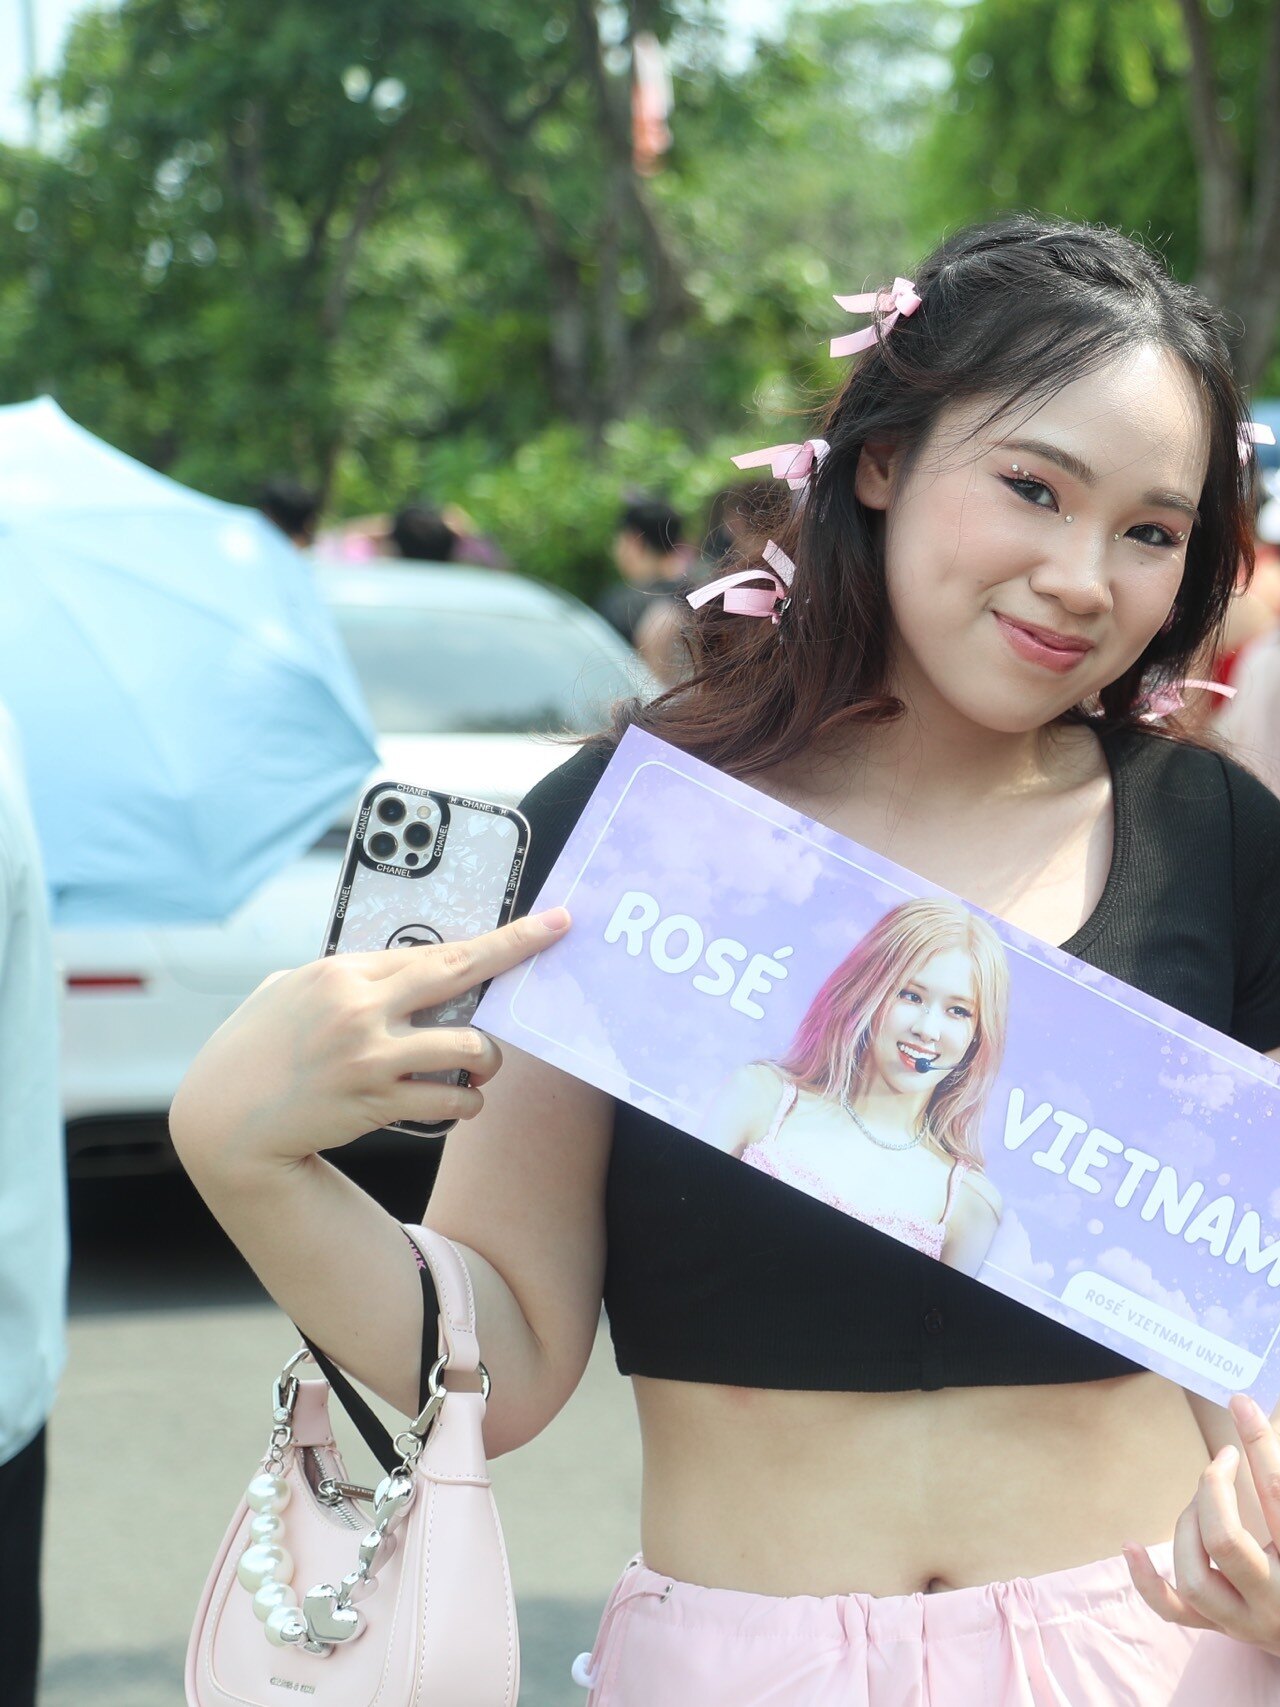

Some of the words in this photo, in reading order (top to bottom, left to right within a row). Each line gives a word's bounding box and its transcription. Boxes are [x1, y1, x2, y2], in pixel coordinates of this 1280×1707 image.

[396, 783, 431, 798] CHANEL
[461, 799, 495, 813] CHANEL
[355, 805, 371, 840] CHANEL
[433, 823, 449, 857] CHANEL
[376, 863, 412, 878] CHANEL
[506, 858, 522, 893] CHANEL
[336, 884, 352, 919] CHANEL
[603, 890, 795, 1020] ROSÉ
[1084, 1288, 1126, 1316] ROSÉ
[1126, 1308, 1194, 1352] VIETNAM
[1195, 1345, 1245, 1379] UNION
